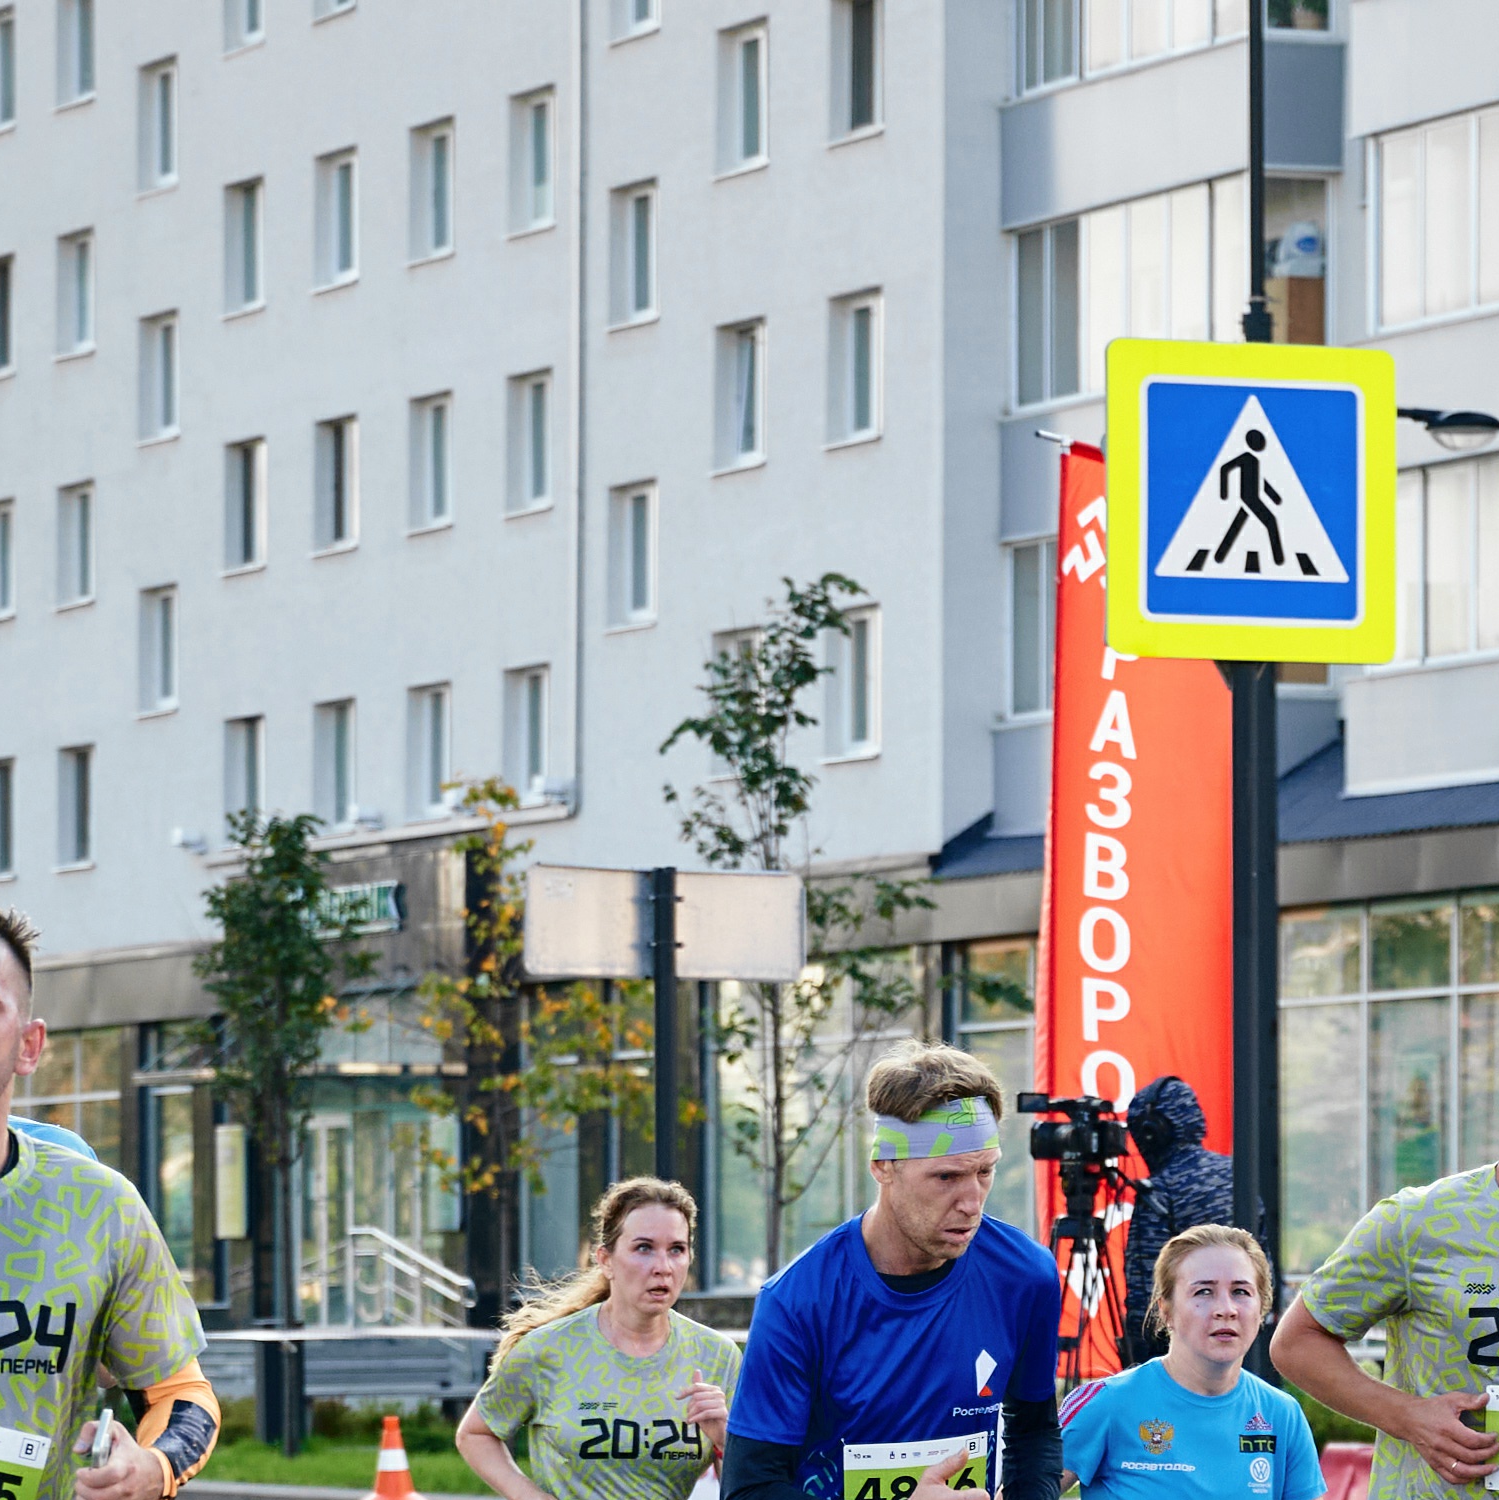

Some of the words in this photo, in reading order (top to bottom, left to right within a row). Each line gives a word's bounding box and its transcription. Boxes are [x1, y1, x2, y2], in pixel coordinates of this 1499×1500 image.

[579, 1417, 702, 1460] 20:24
[25, 1443, 34, 1456] B
[969, 1441, 976, 1451] B
